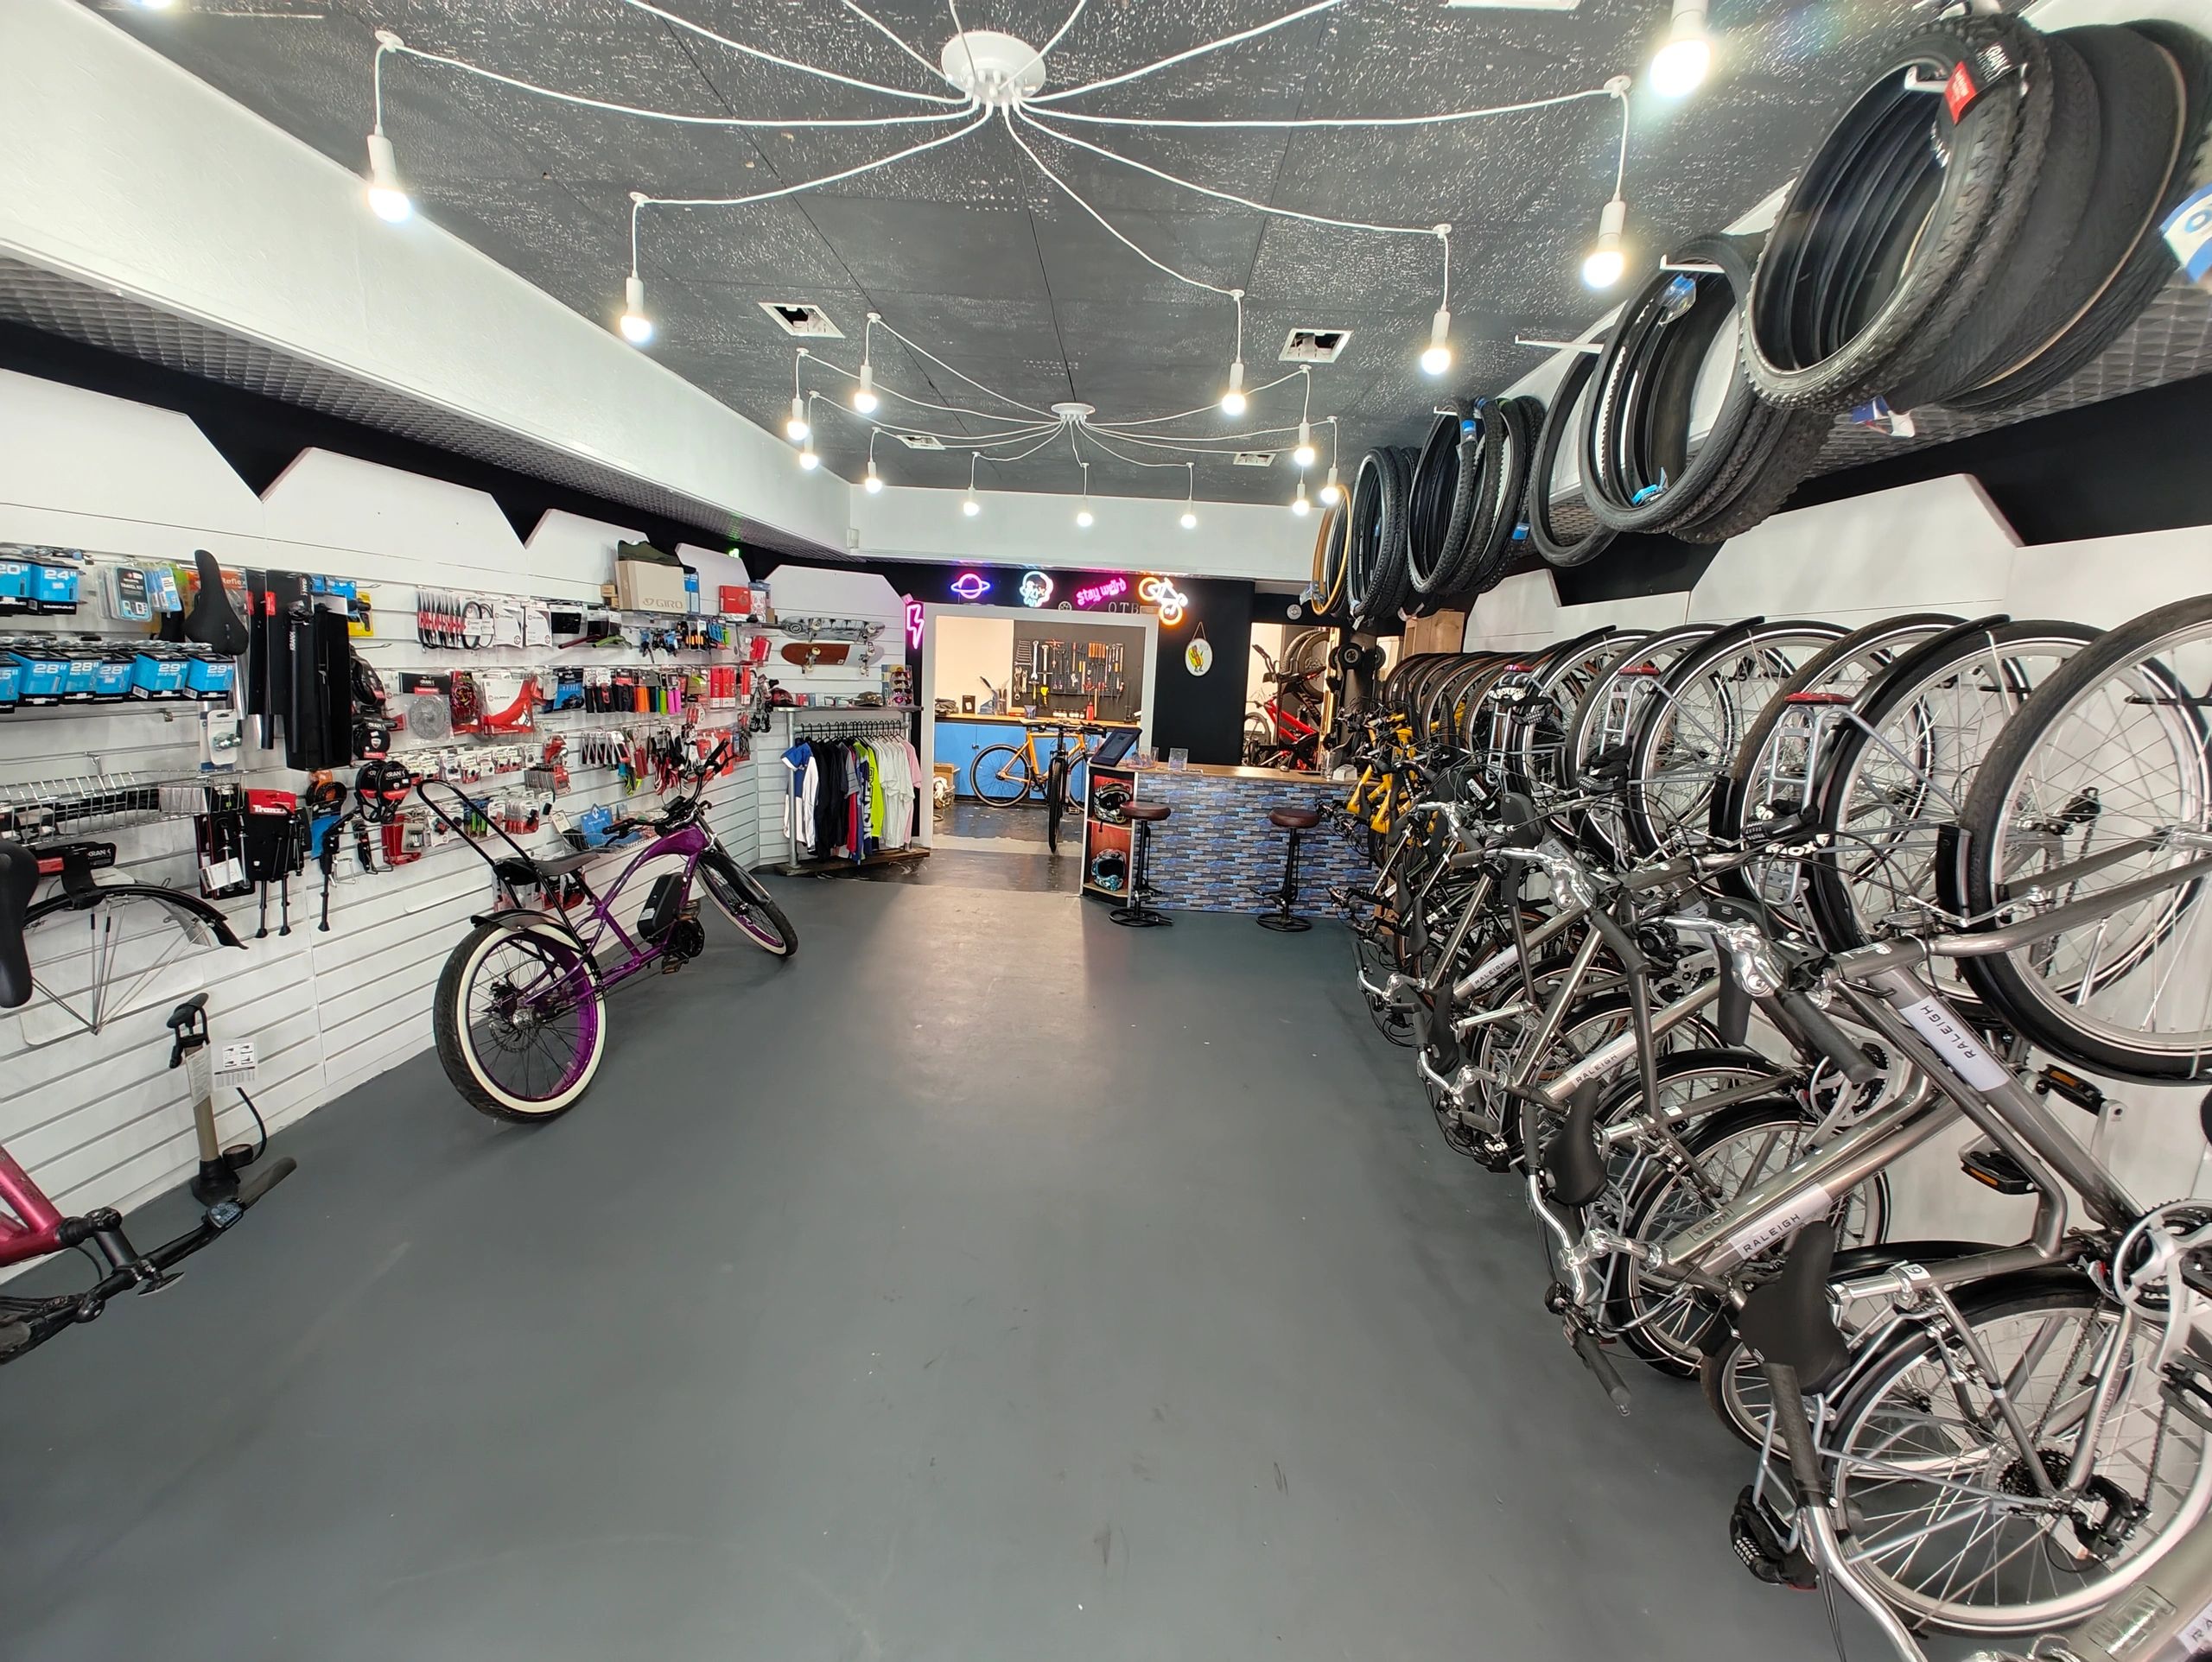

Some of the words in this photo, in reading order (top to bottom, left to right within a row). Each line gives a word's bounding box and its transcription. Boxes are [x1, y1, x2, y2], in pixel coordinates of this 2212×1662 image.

[44, 569, 77, 580] 24"
[1077, 587, 1102, 606] stay
[1099, 577, 1127, 596] weird
[656, 598, 683, 609] GIRO
[33, 663, 67, 674] 28"
[70, 662, 99, 672] 28"
[158, 663, 188, 673] 29"
[207, 664, 233, 674] 29"
[1474, 961, 1506, 985] RALEIGH
[1920, 1005, 1977, 1059] RALEIGH
[1575, 1054, 1618, 1084] RALEIGH
[1742, 1213, 1801, 1253] RALEIGH
